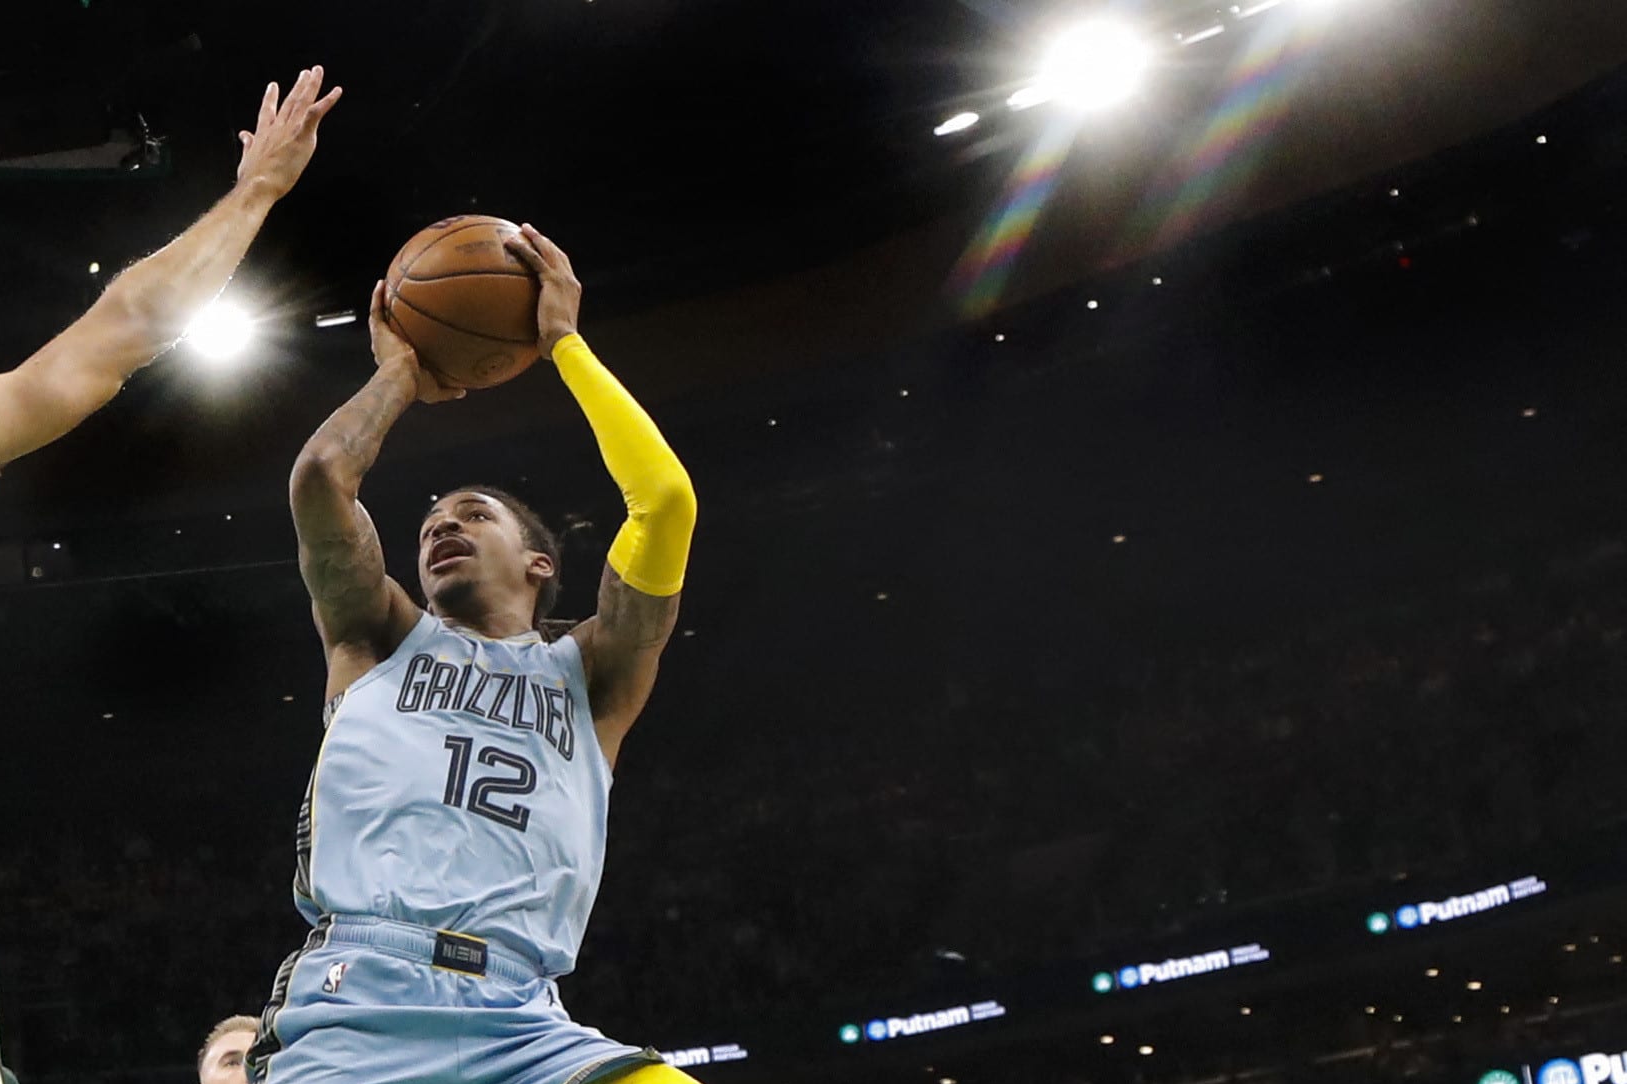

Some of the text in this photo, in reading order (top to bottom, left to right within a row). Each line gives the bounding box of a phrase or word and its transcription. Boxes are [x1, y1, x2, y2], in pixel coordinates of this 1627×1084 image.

[396, 653, 574, 762] GRIZZLIES
[443, 734, 537, 832] 12
[1419, 884, 1510, 924] Putnam
[1139, 950, 1230, 985] Putnam
[886, 1006, 970, 1038] Putnam
